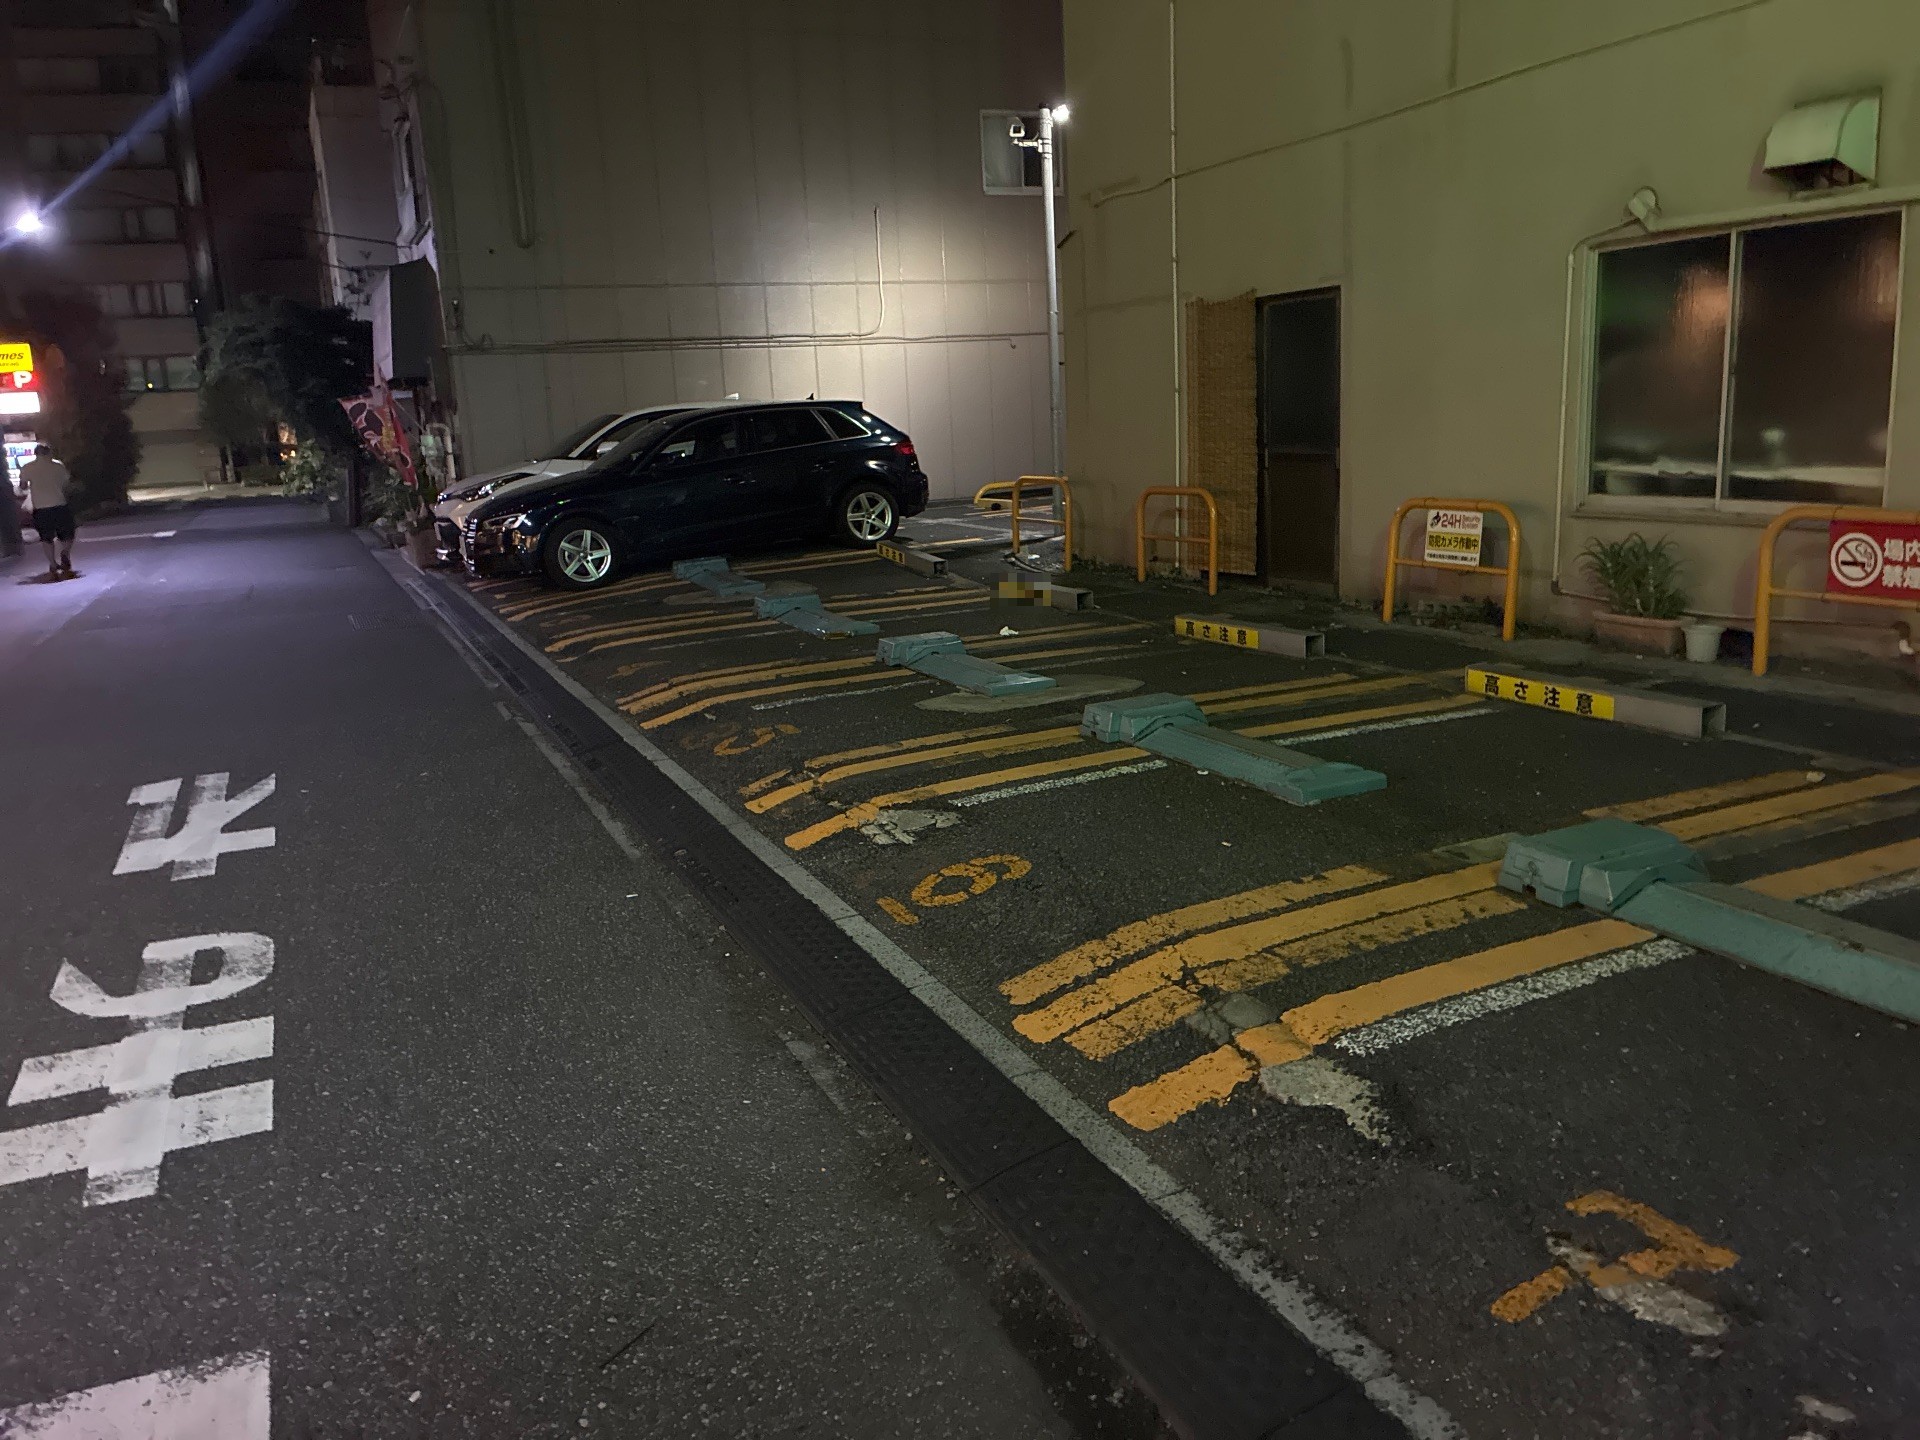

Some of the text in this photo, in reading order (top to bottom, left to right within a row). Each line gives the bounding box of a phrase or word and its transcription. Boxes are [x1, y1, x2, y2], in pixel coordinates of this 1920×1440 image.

[1441, 513, 1461, 529] 24H
[1428, 534, 1479, 550] 防犯カメラ作動中
[1185, 620, 1247, 645] 高さ注意
[1484, 674, 1594, 715] 高さ注意
